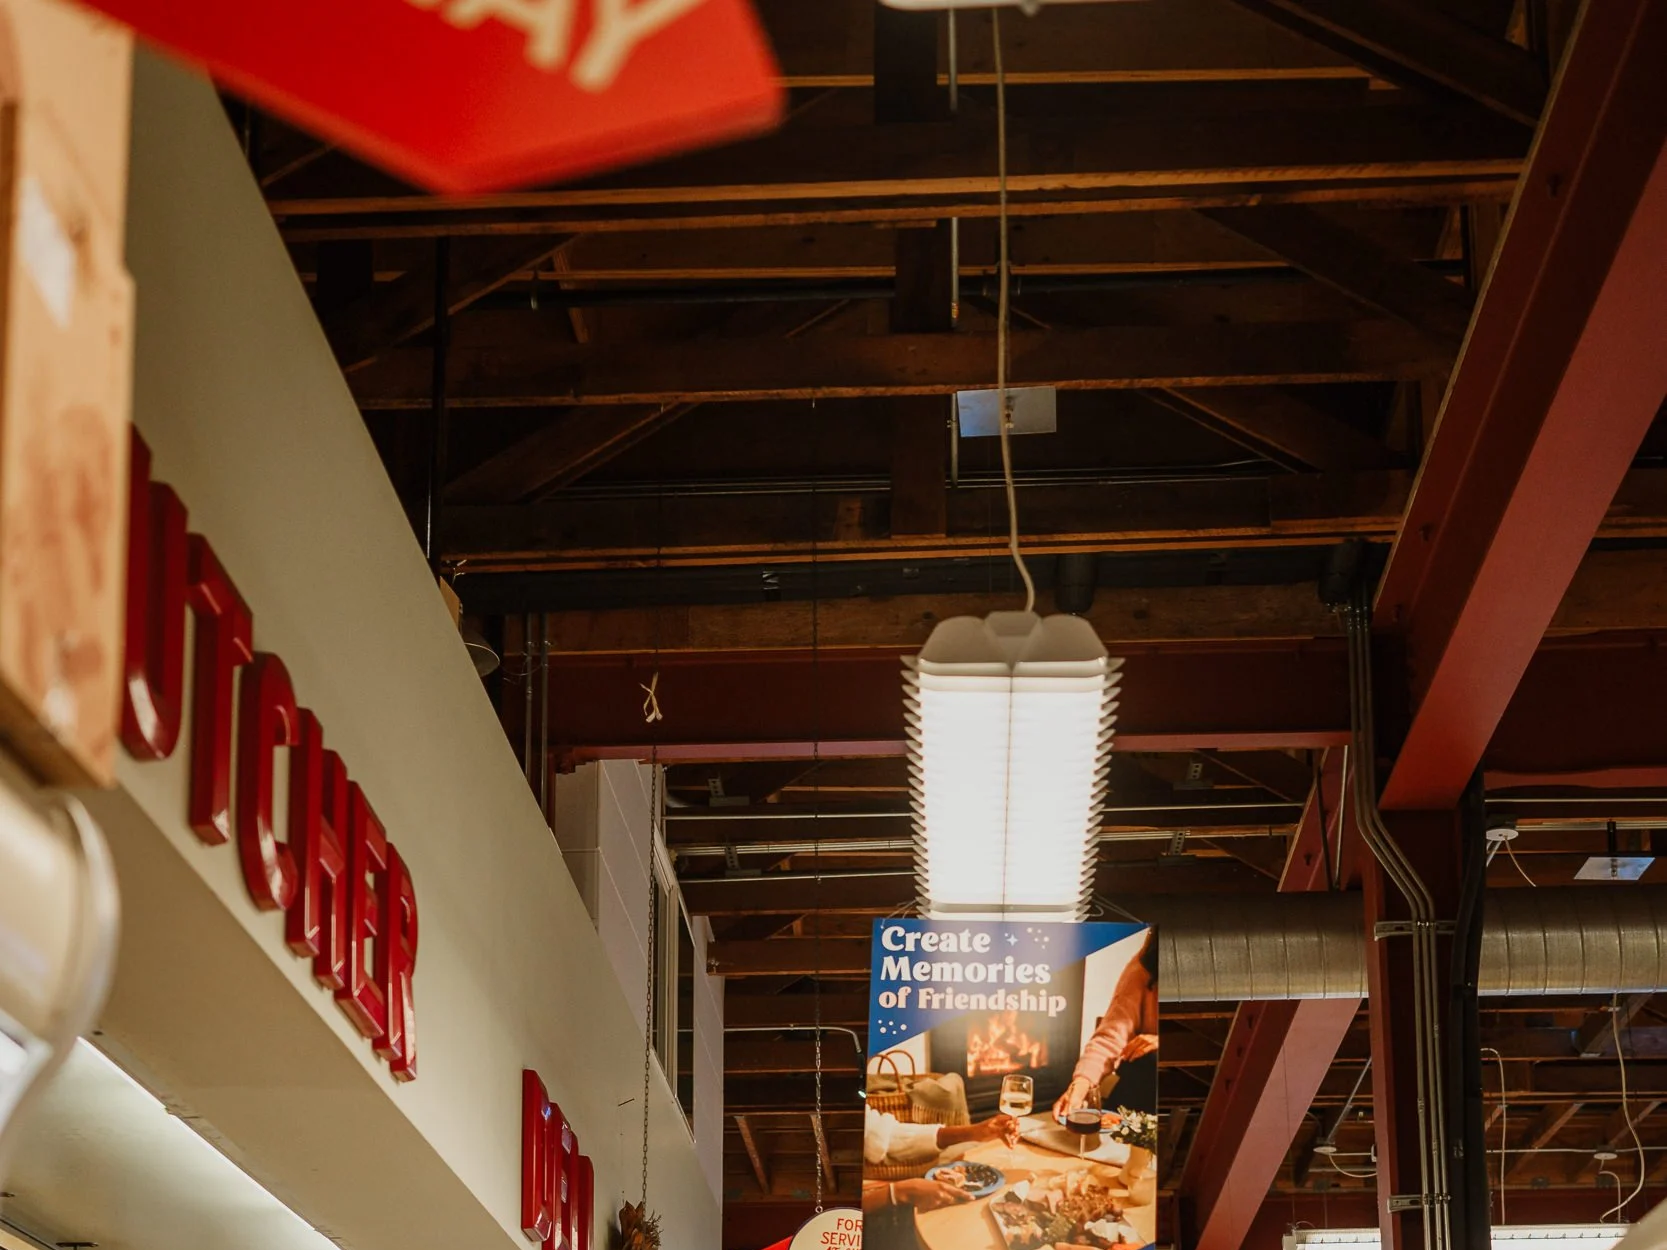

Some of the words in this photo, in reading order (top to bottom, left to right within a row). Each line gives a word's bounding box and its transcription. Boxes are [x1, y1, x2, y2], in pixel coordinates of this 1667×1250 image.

[114, 420, 419, 1082] UTCHER
[881, 925, 992, 953] Create
[880, 955, 1051, 985] Memories
[878, 986, 913, 1009] of
[917, 986, 1068, 1018] Friendship
[820, 1231, 861, 1247] SERVI
